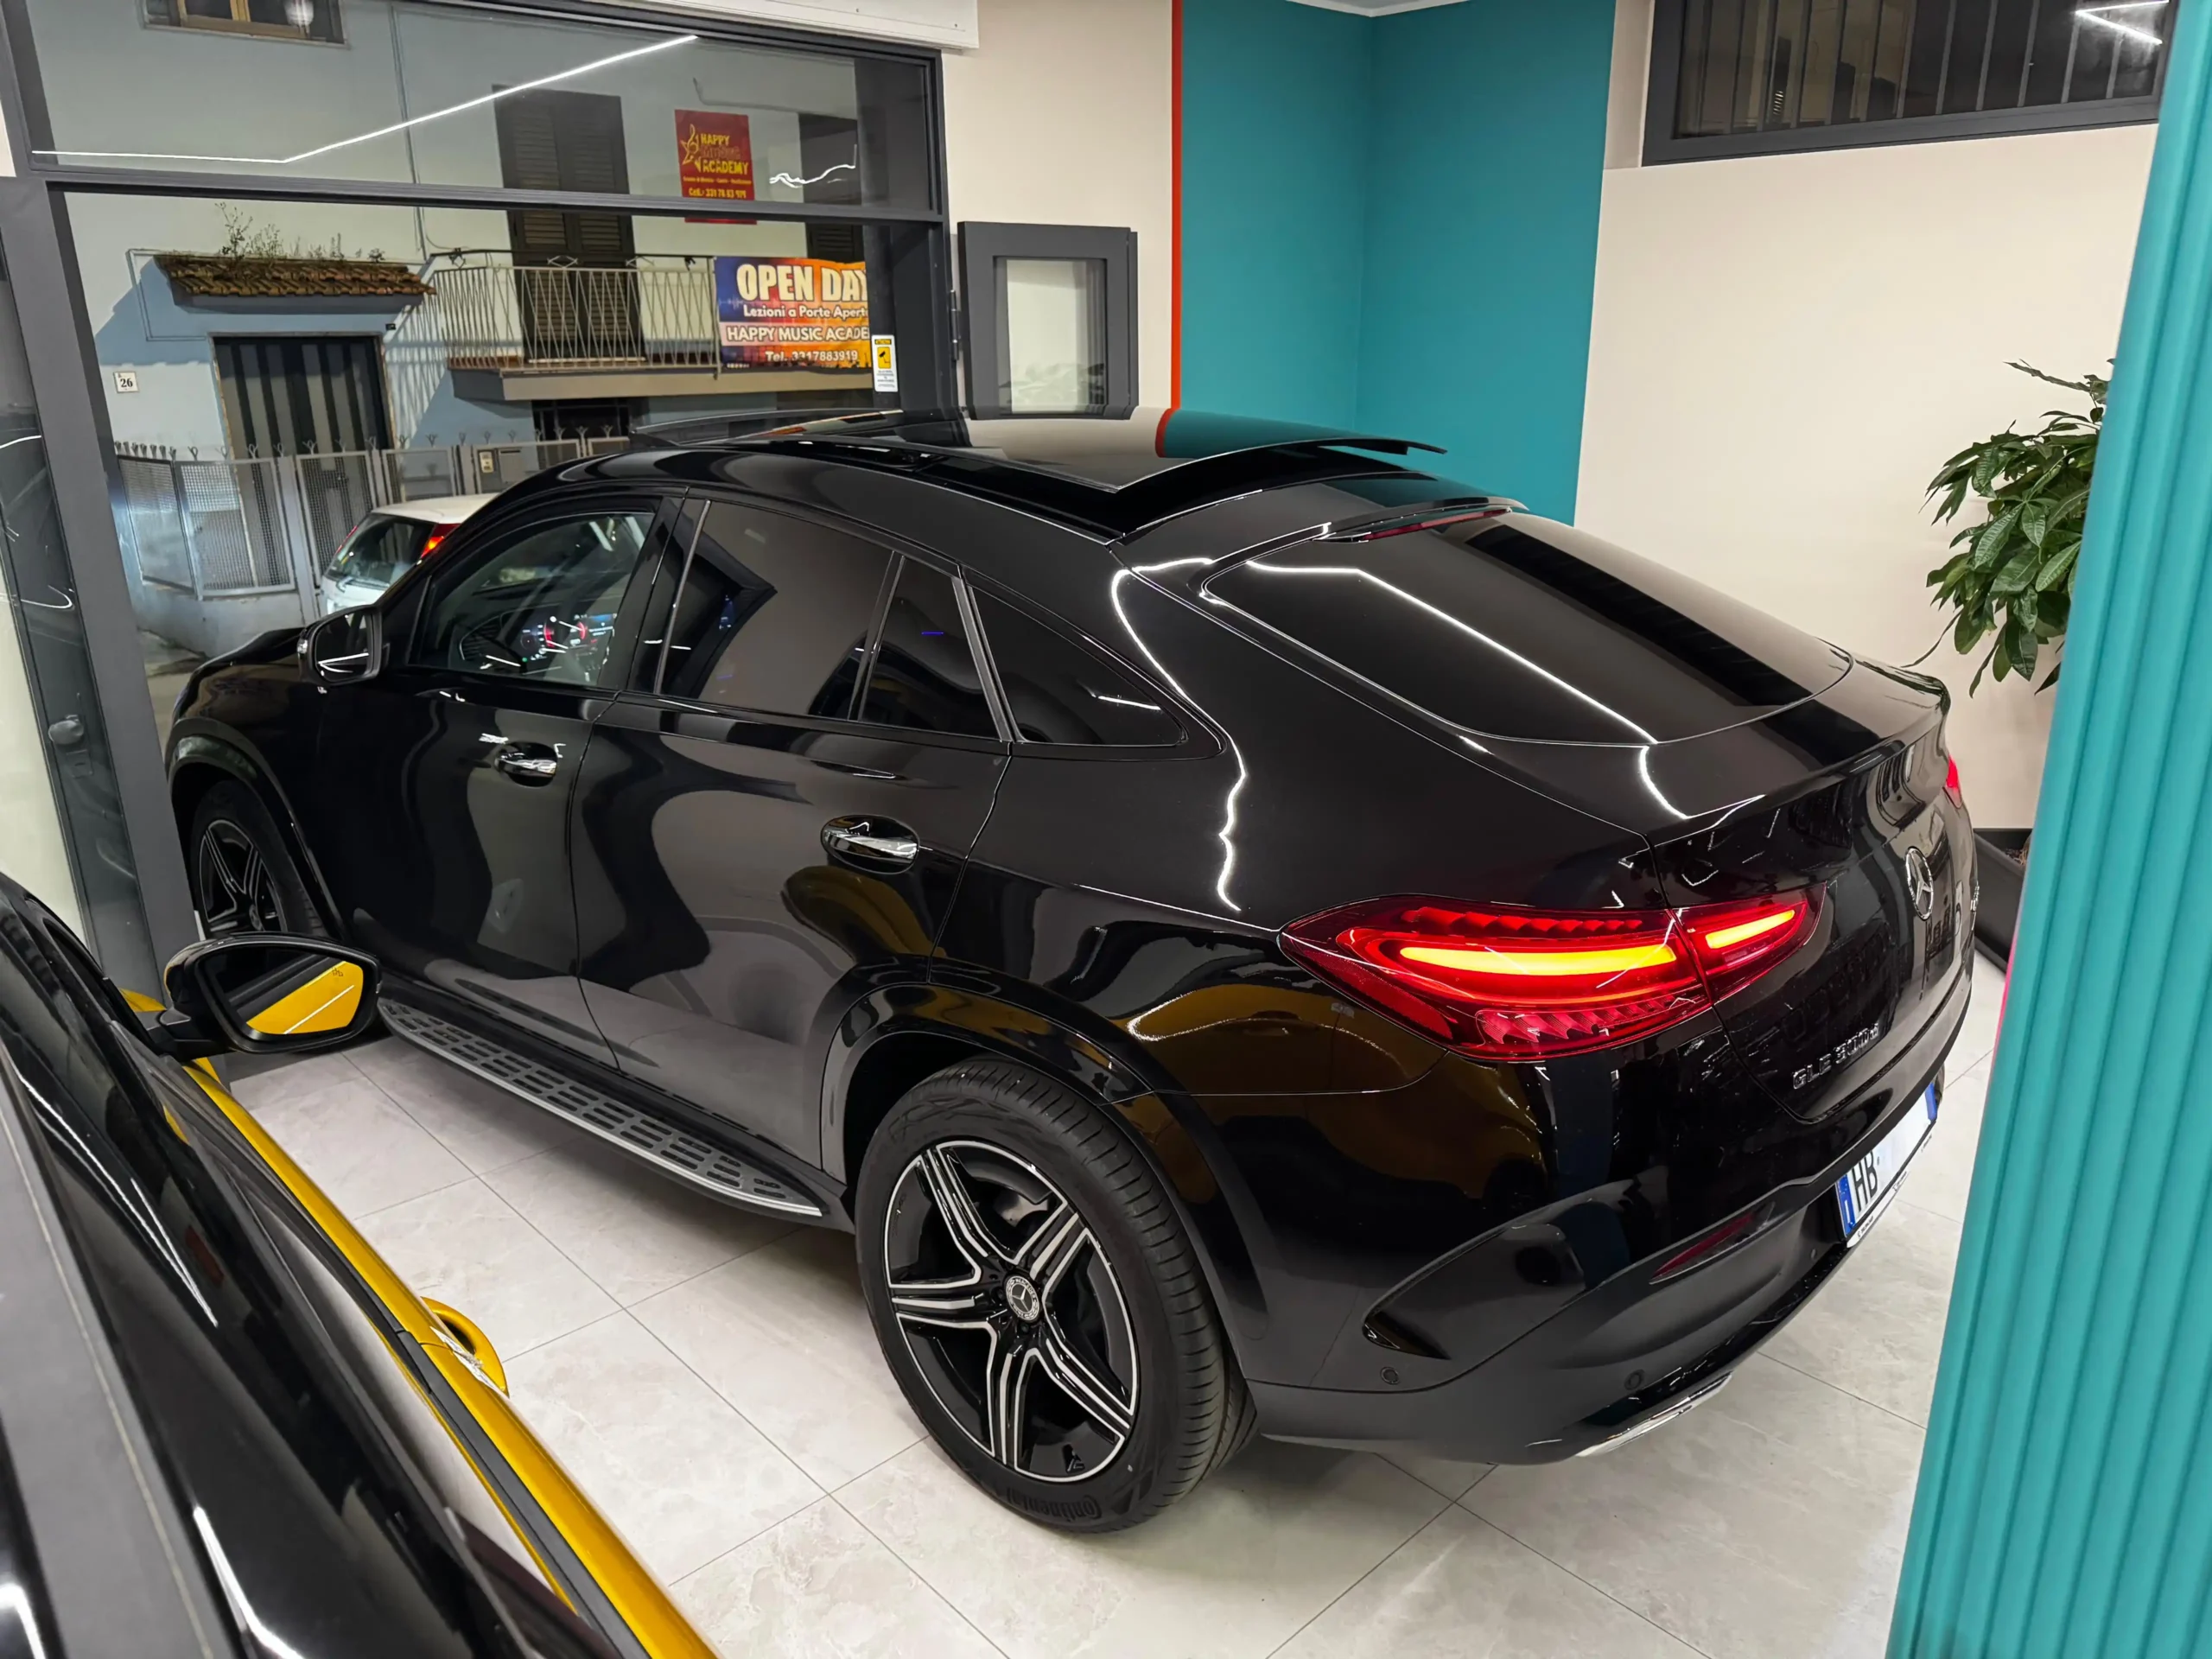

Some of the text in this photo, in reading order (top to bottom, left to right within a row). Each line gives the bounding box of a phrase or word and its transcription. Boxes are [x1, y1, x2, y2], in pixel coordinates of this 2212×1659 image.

[701, 133, 730, 146] HAPPY
[702, 160, 748, 175] ACADEMY
[736, 264, 815, 302] OPEN
[743, 305, 785, 318] Lezioni
[788, 308, 797, 318] a
[798, 305, 830, 318] Porte
[727, 326, 870, 341] HAPPY MUSIC ACADE
[765, 351, 788, 362] Tel.
[119, 378, 133, 388] 26
[1793, 1053, 1833, 1090] GLE
[1007, 1487, 1103, 1522] Continental
